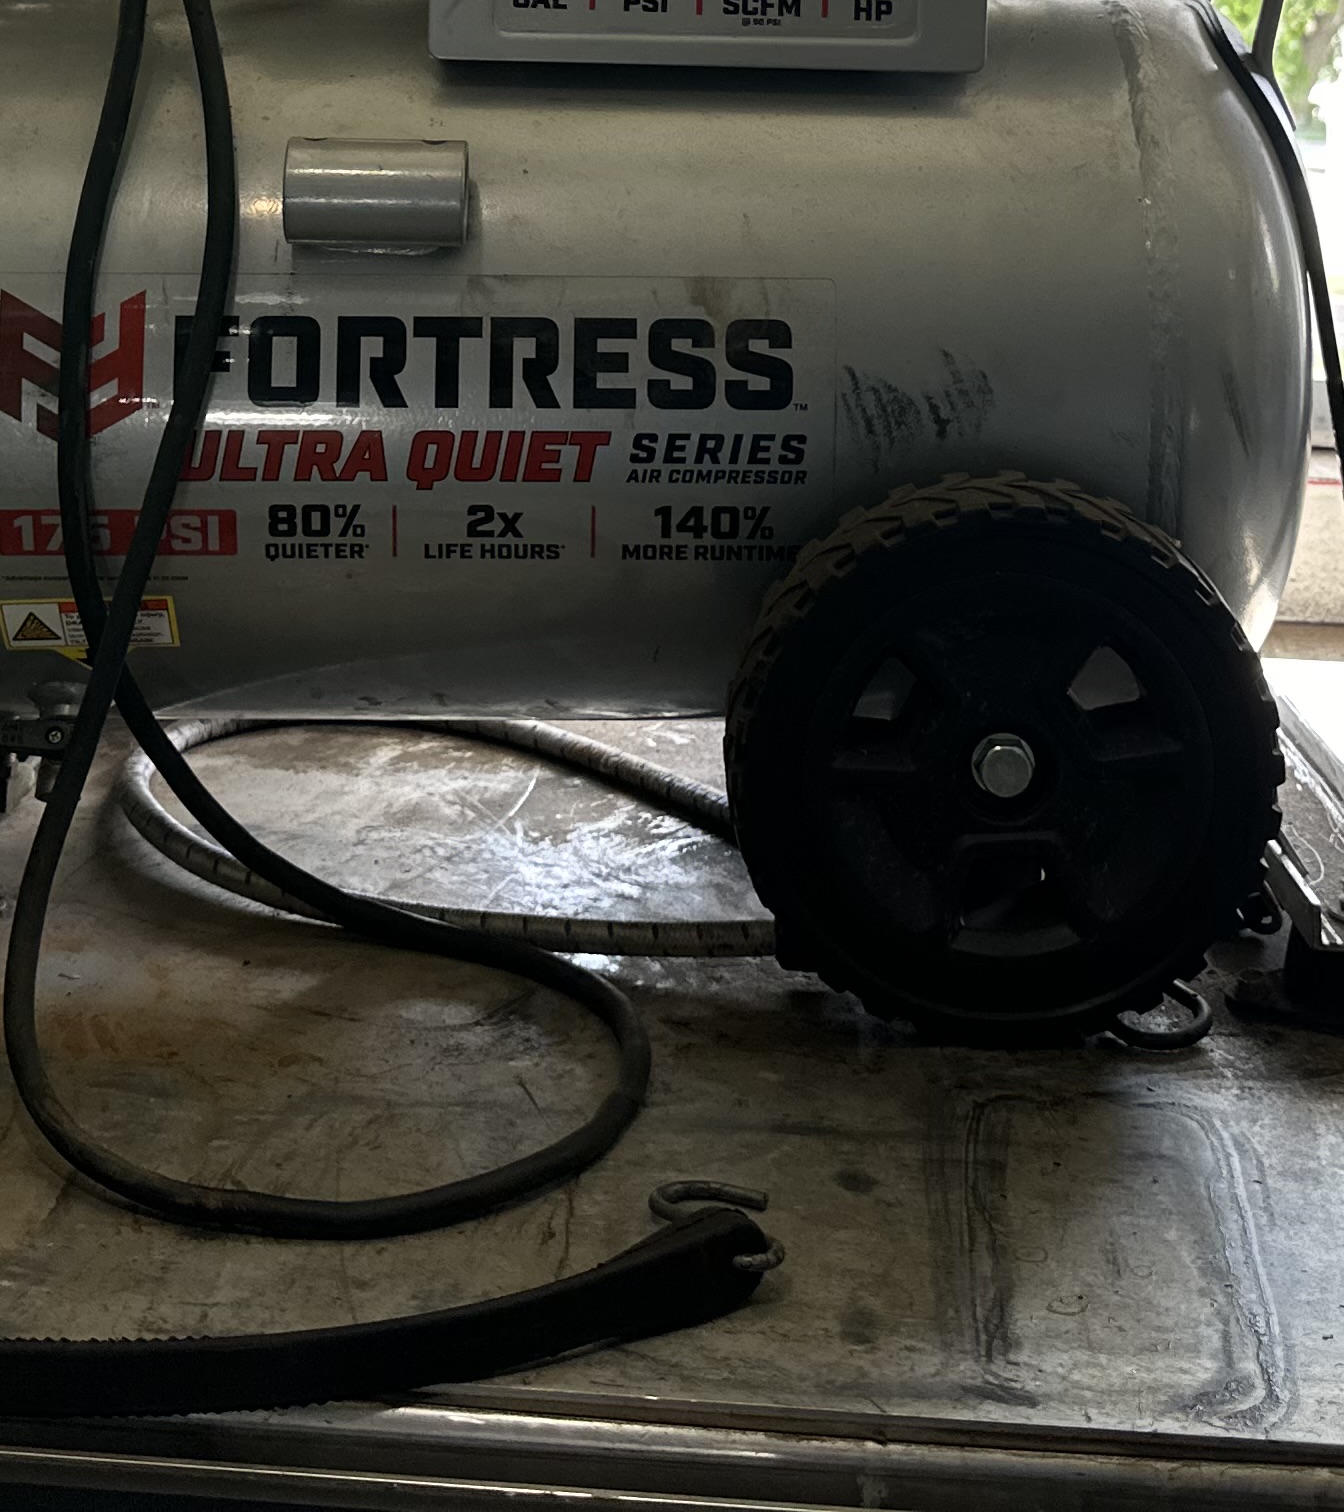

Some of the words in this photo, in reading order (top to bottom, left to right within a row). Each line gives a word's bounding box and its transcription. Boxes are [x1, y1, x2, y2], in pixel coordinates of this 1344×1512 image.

[853, 0, 893, 21] HP
[179, 430, 388, 482] ULTRA
[406, 430, 611, 490] QUIET
[629, 433, 808, 465] SERIES
[626, 469, 662, 484] AIR
[668, 469, 808, 485] COMPRESSOR
[267, 504, 365, 538] 80%
[467, 504, 524, 539] 2x
[654, 505, 774, 540] 140%
[423, 543, 473, 560] LIFE
[621, 544, 688, 561] MORE
